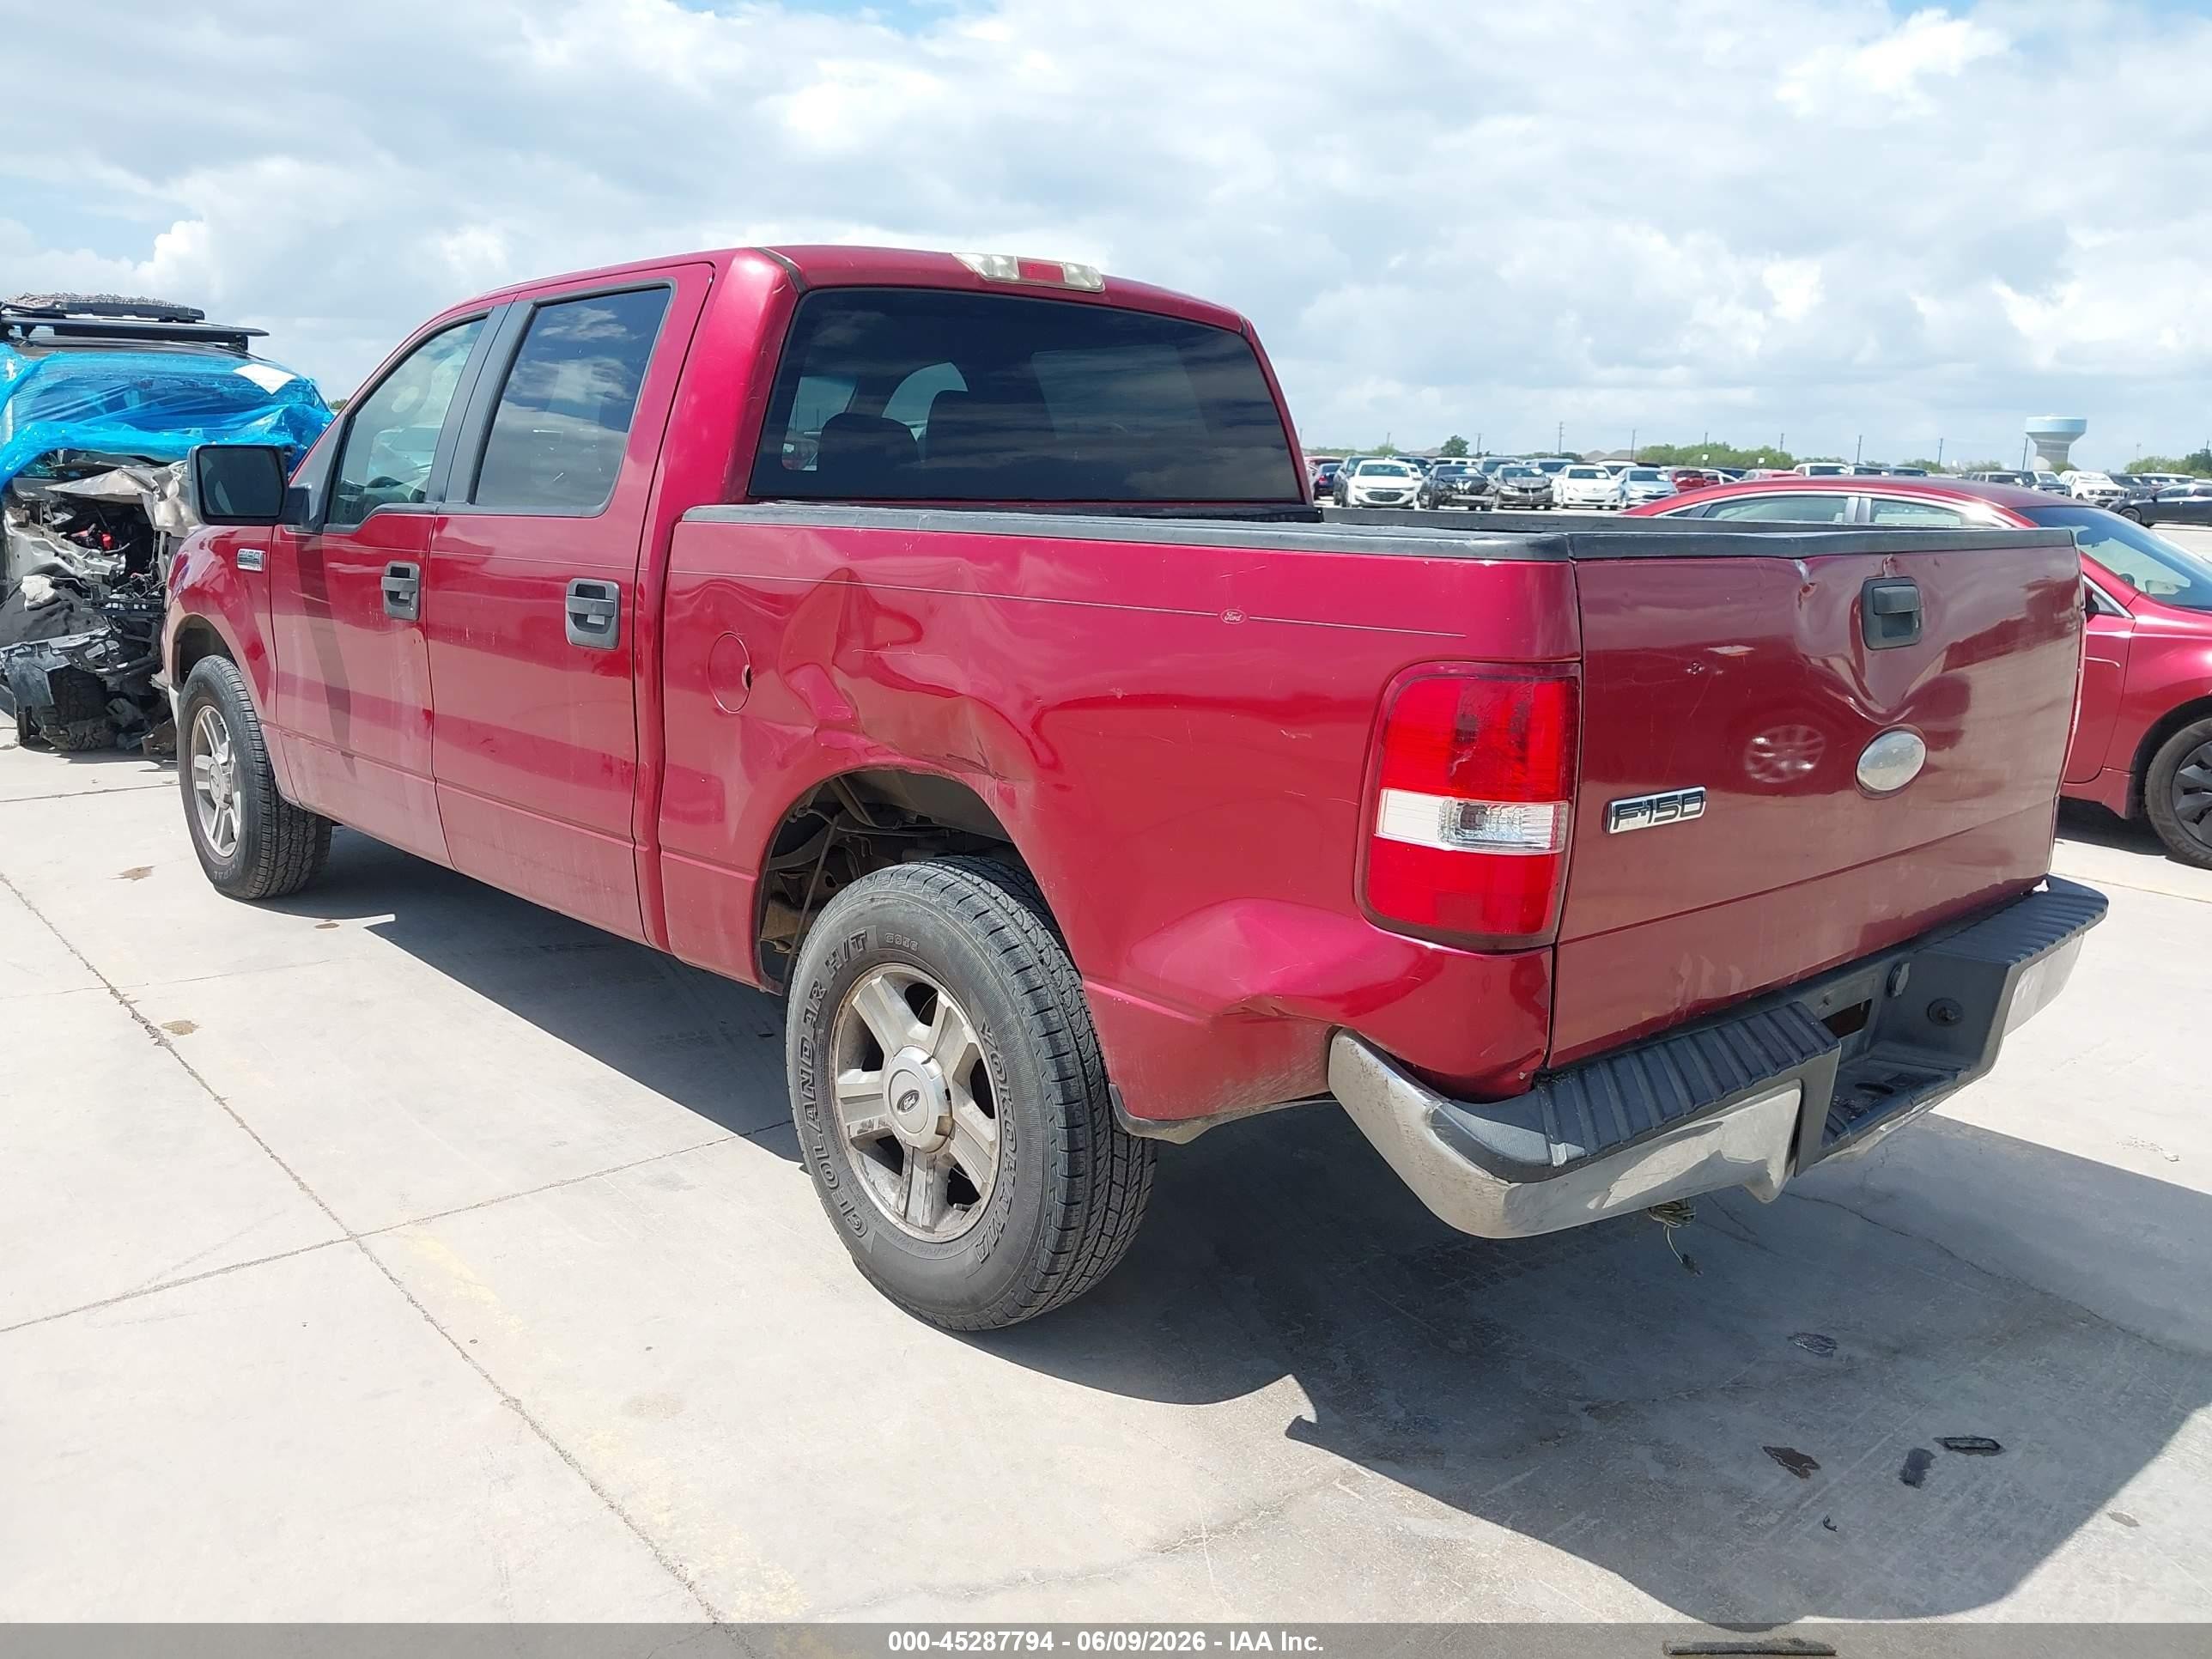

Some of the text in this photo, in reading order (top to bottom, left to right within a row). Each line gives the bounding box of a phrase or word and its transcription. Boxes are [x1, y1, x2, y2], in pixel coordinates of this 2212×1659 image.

[1224, 611, 1243, 622] Ford
[824, 928, 867, 980] H/T
[976, 1017, 1018, 1264] YOKOHAMA
